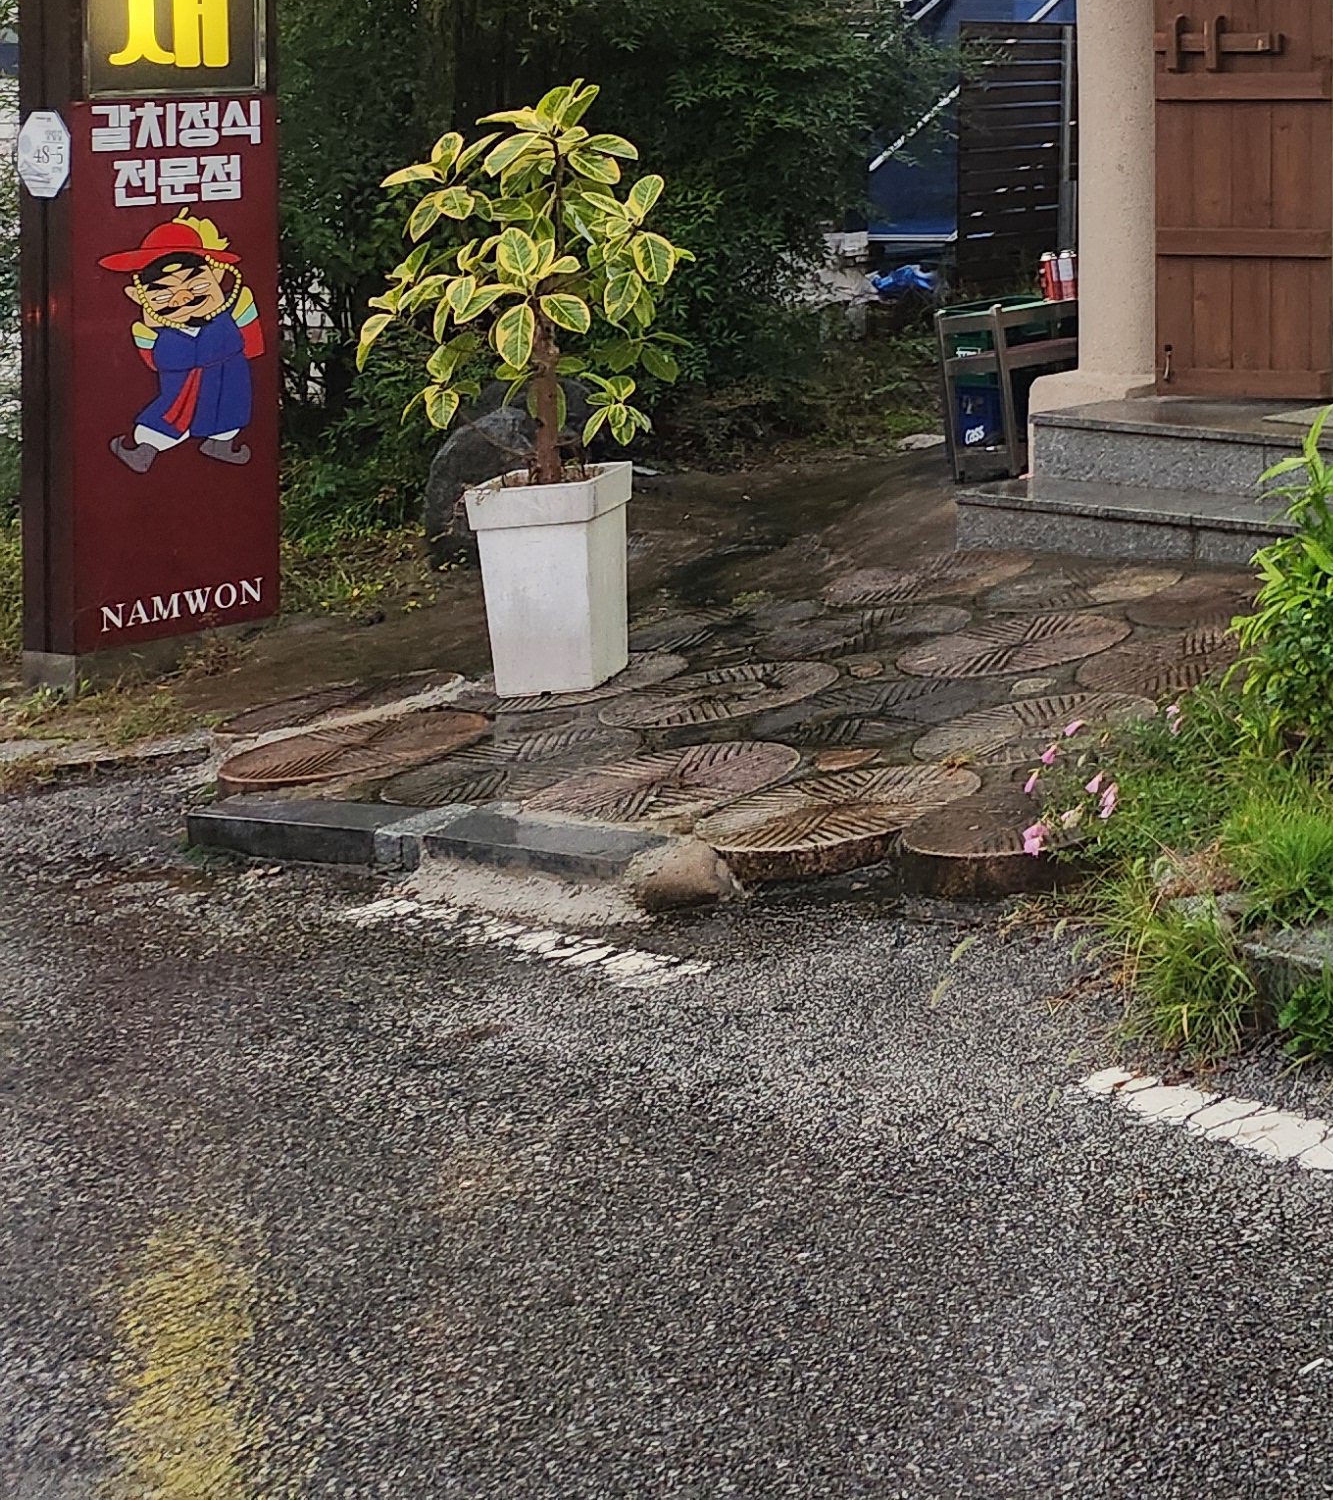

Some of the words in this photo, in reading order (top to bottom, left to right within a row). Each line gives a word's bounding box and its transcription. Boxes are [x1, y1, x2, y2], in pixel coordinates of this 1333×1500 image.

[91, 100, 262, 153] 갈치정식
[33, 145, 63, 164] 48-5
[113, 156, 242, 208] 전문점
[100, 578, 264, 633] NAMWON
